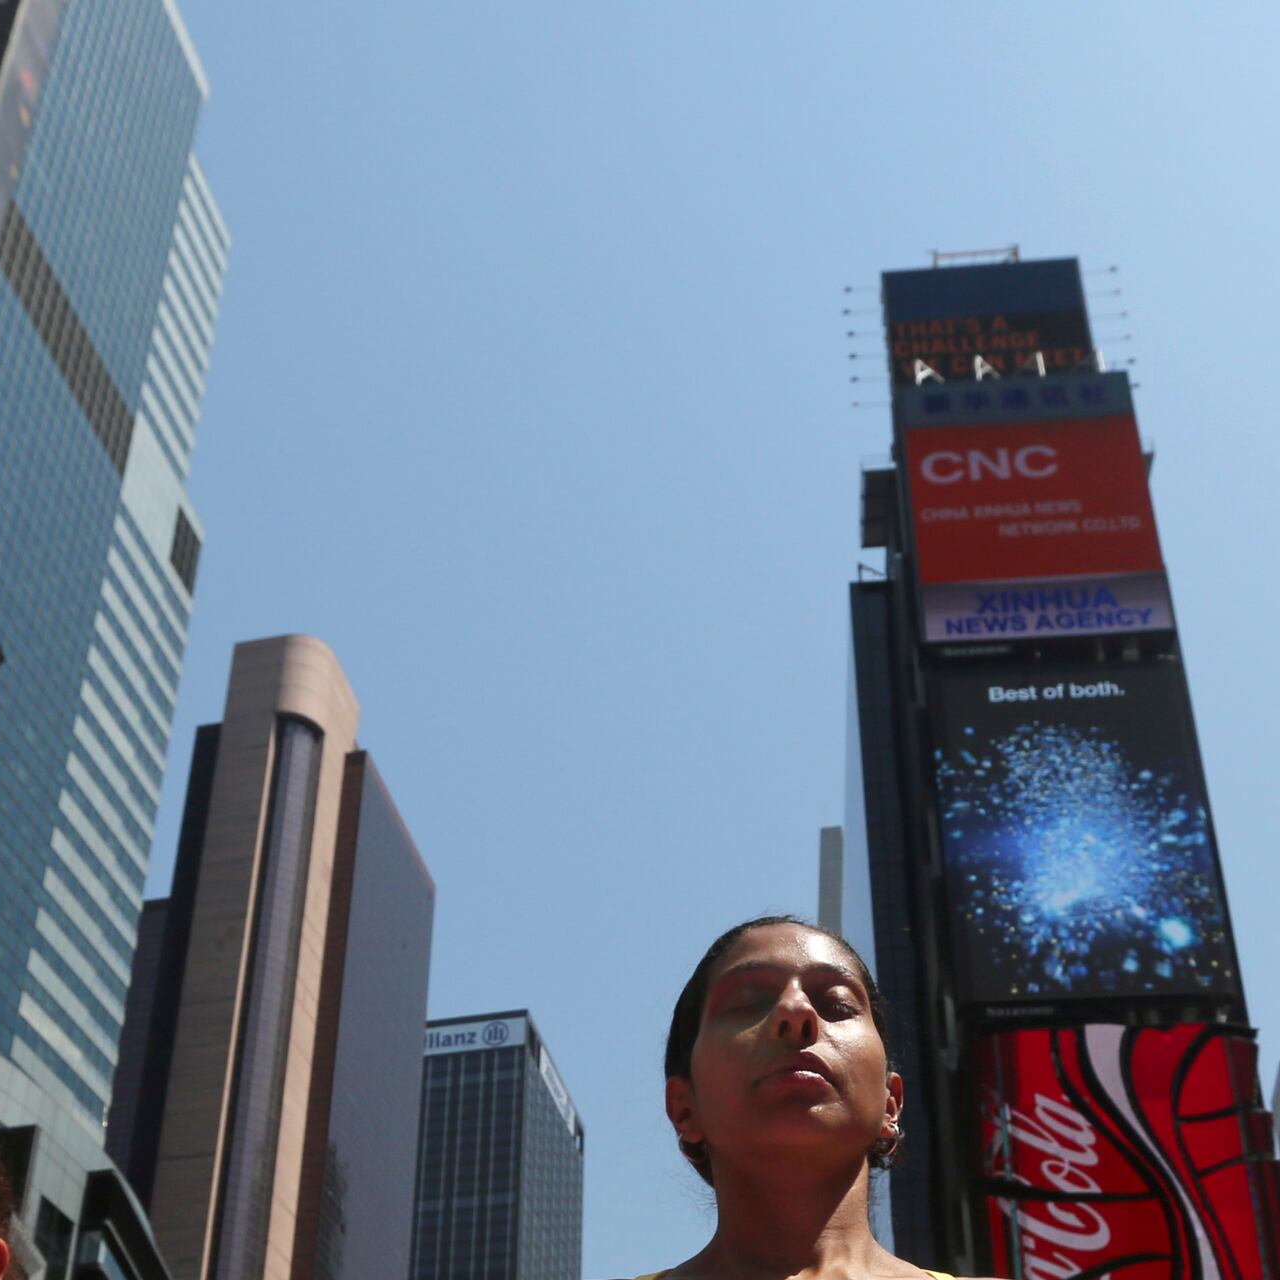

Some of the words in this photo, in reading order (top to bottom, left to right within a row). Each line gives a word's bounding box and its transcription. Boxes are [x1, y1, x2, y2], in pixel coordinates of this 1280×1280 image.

[920, 444, 1059, 485] CNC
[921, 506, 968, 522] CHINA
[1035, 499, 1082, 514] NEWS
[999, 519, 1079, 537] NETWORK
[976, 586, 1119, 616] XINHUA
[945, 615, 1028, 636] NEWS
[1035, 607, 1153, 631] AGENCY
[988, 685, 1038, 703] Best
[1042, 683, 1064, 700] of
[1069, 680, 1125, 699] both.
[424, 1029, 477, 1049] llianz
